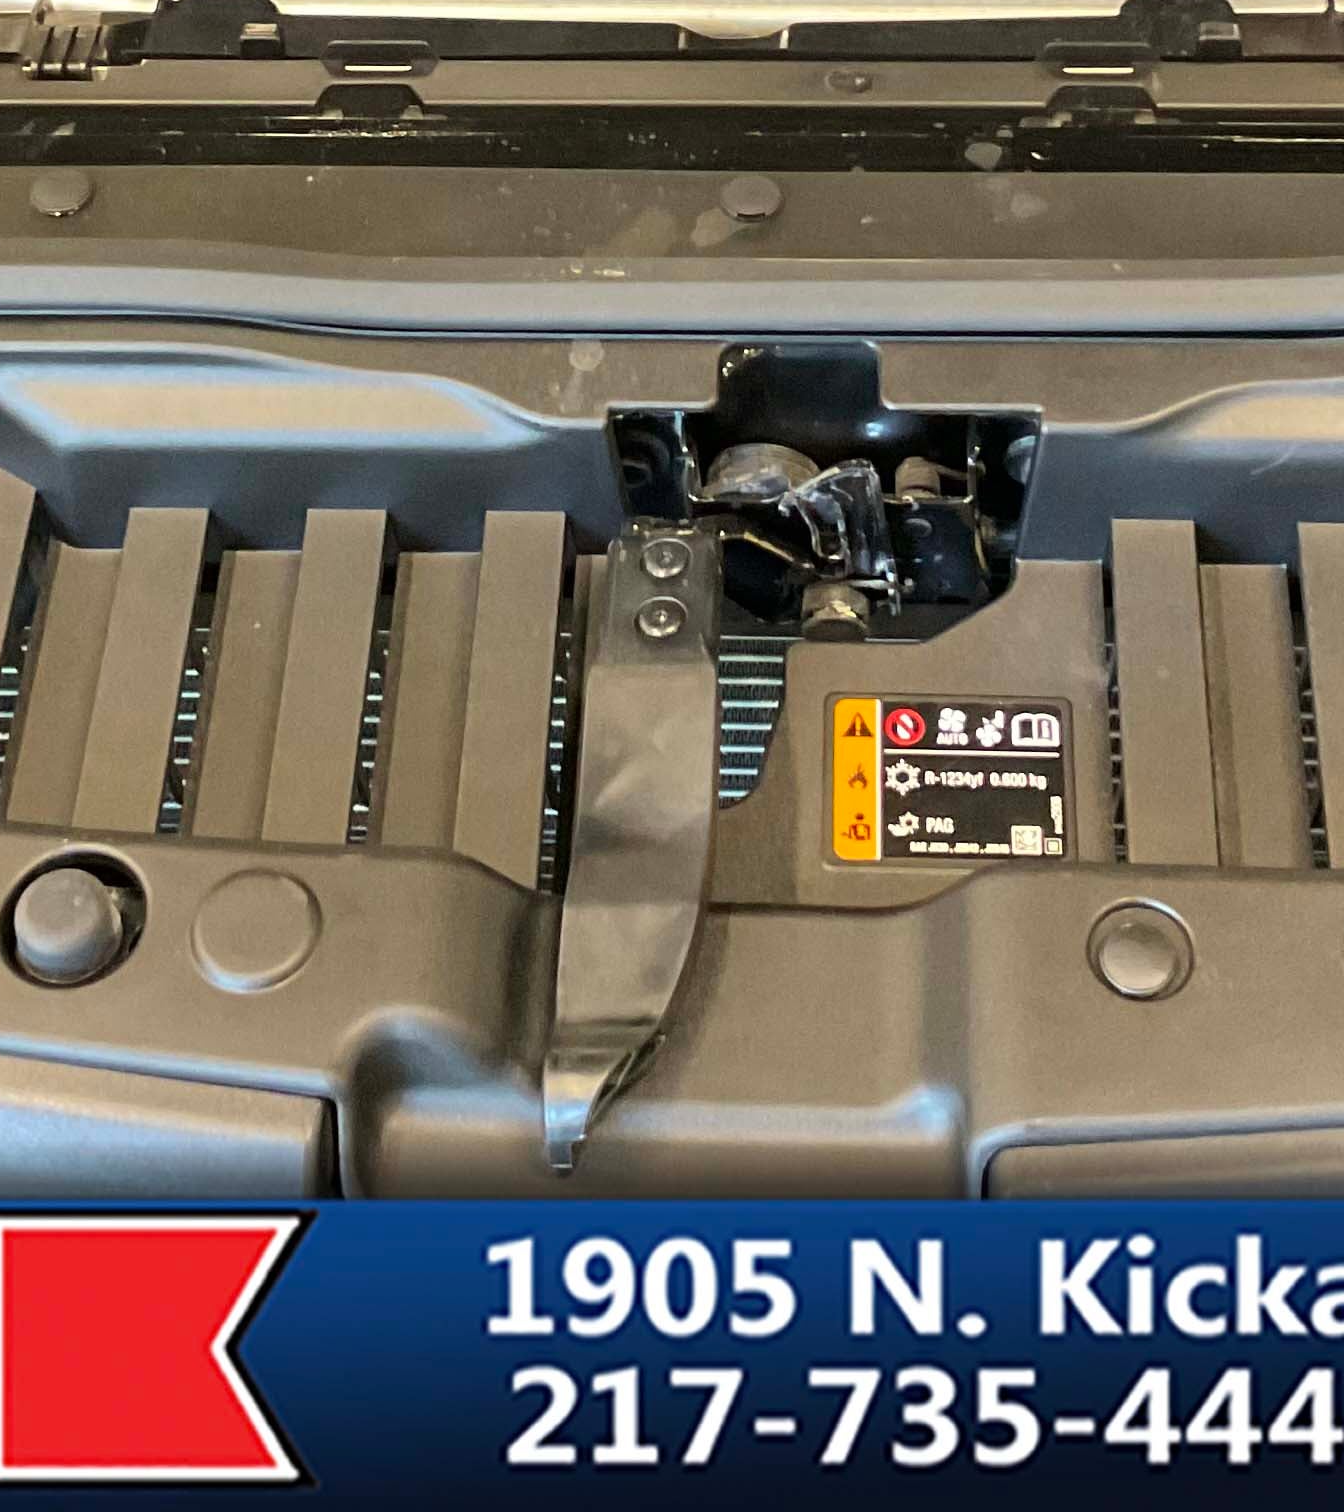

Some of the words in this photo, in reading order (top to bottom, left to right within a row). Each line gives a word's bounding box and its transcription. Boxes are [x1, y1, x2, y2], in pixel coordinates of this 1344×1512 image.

[936, 731, 969, 746] AUTO
[924, 770, 984, 789] R-1234yf
[1028, 772, 1047, 790] kg
[925, 816, 955, 834] PAG
